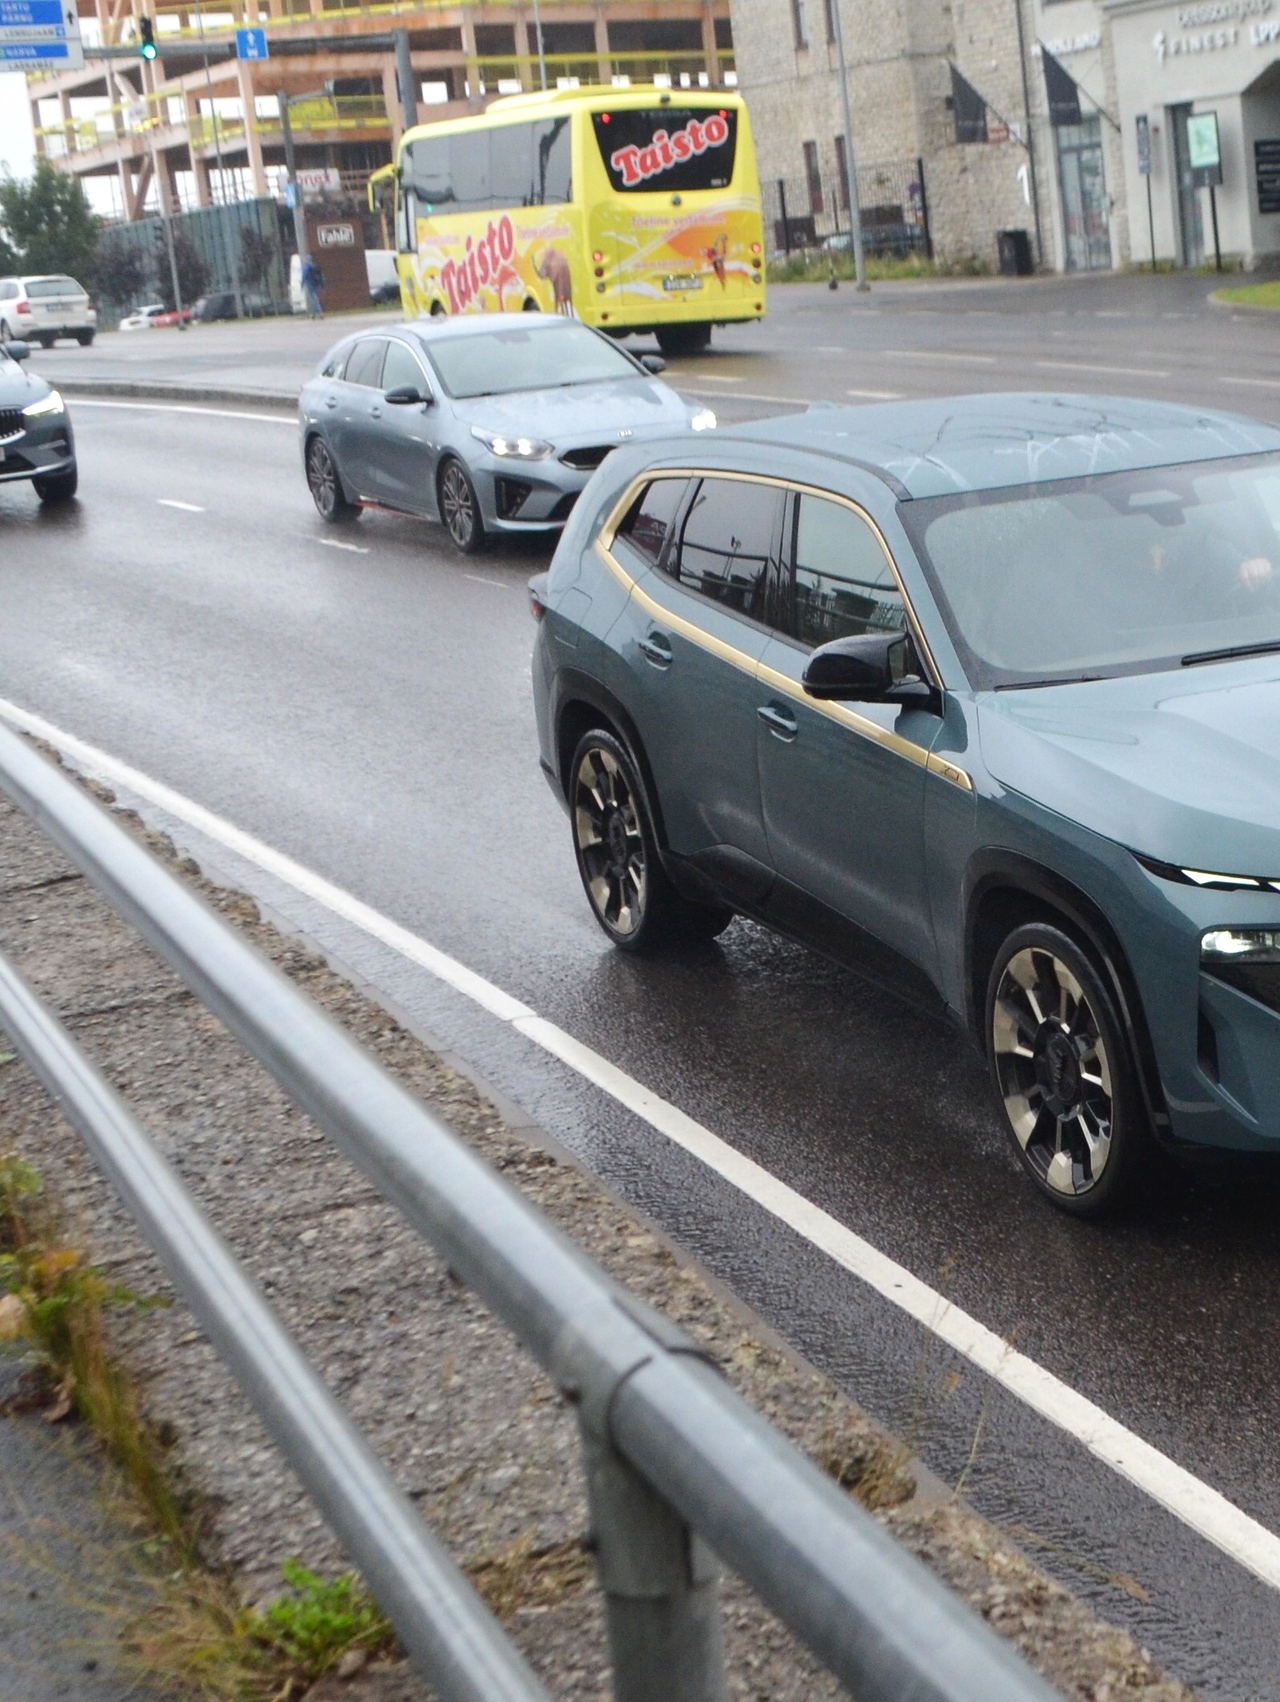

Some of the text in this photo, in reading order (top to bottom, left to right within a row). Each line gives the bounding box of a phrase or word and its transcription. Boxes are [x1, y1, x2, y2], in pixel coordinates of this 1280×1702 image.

[611, 115, 728, 187] Taisto
[320, 227, 352, 244] Fahle
[441, 214, 514, 314] Taisto
